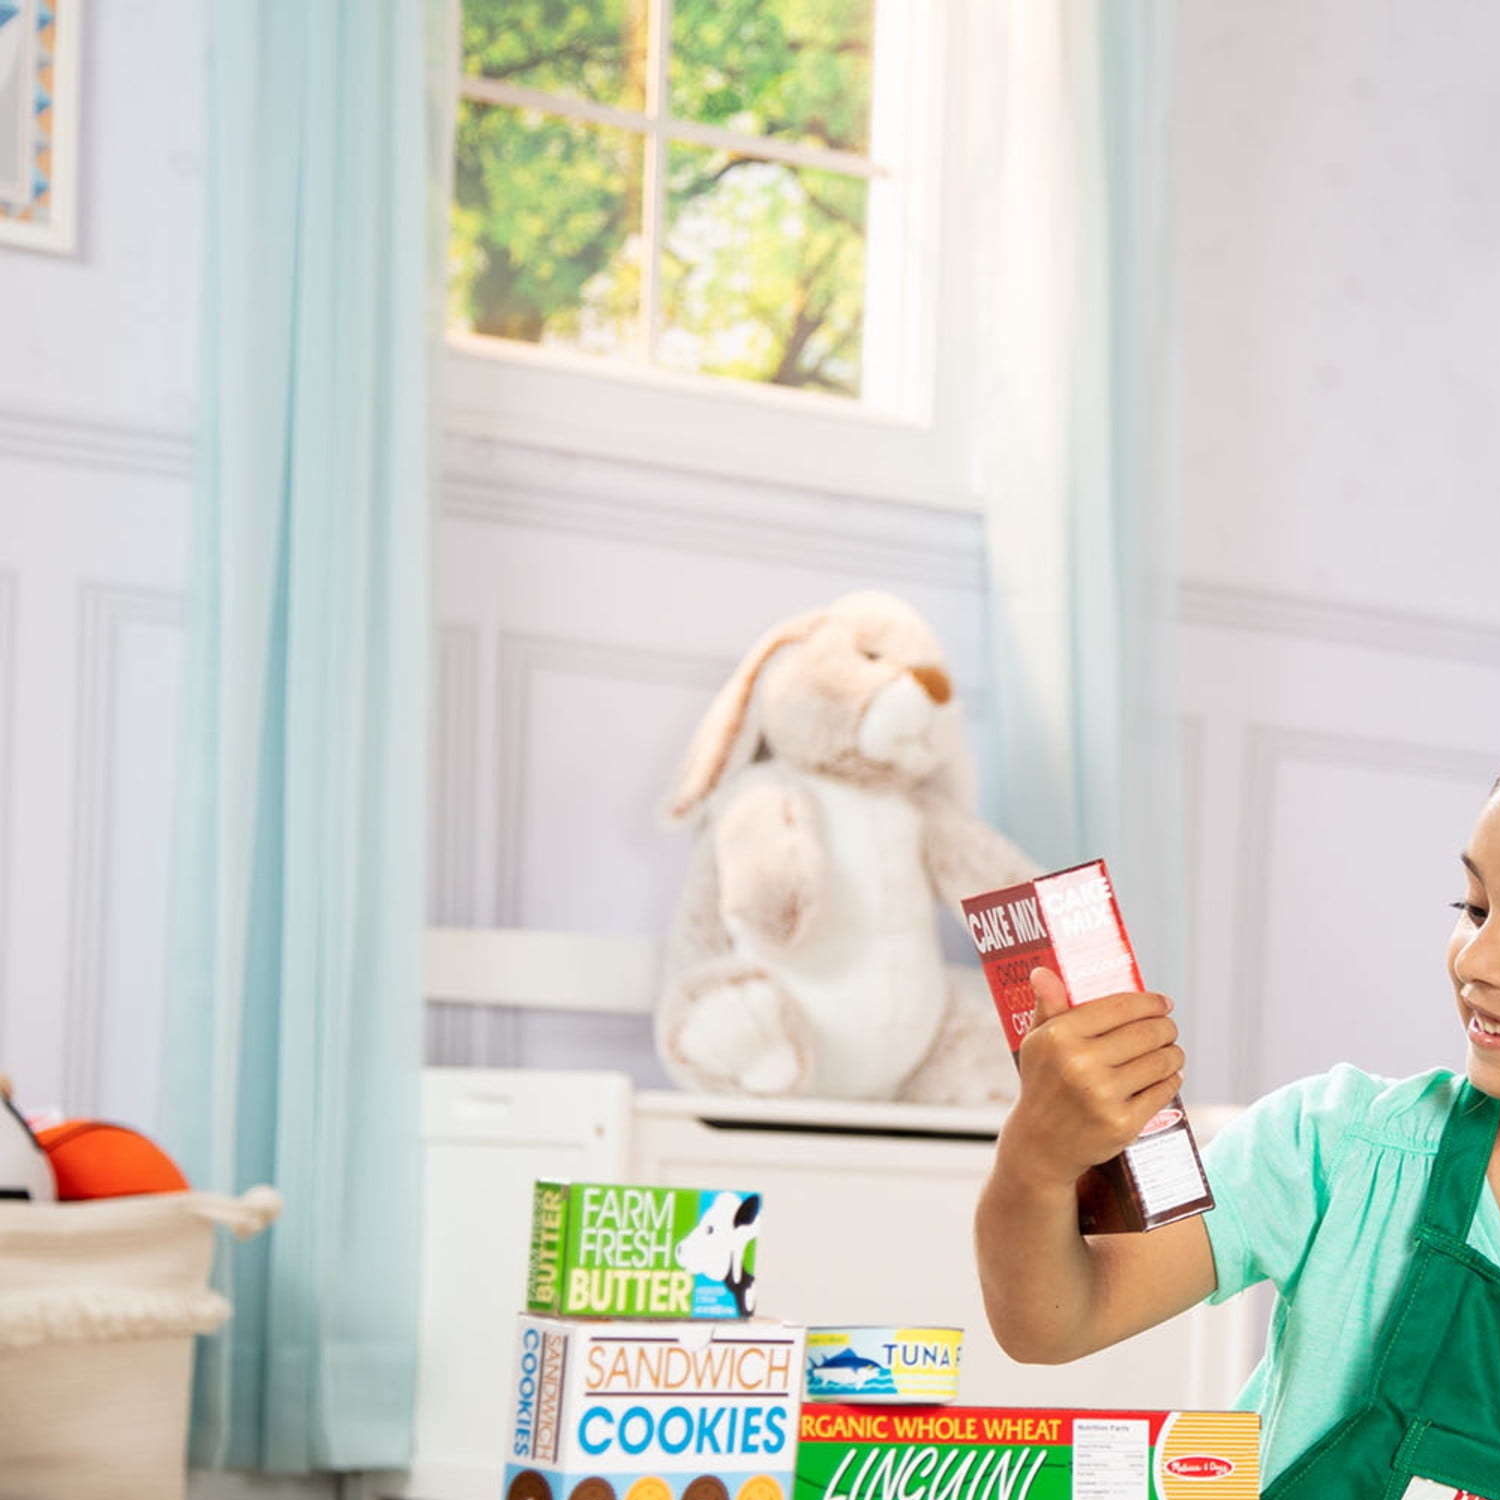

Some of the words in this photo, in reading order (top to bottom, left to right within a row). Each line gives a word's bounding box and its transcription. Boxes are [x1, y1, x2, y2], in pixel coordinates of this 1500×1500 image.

[968, 906, 1015, 954] CAKE
[1008, 897, 1047, 944] MIX
[582, 1188, 675, 1230] FARM
[536, 1190, 563, 1304] BUTTER
[579, 1227, 673, 1268] FRESH
[568, 1268, 695, 1312] BUTTER
[586, 1345, 791, 1390] SANDWICH
[882, 1344, 950, 1367] TUNA
[513, 1328, 540, 1457] COOKIES
[537, 1334, 562, 1461] SANDWICH
[578, 1405, 788, 1455] COOKIES
[800, 1415, 888, 1439] RGANIC
[893, 1417, 979, 1440] WHOLE
[983, 1419, 1062, 1441] WHEAT
